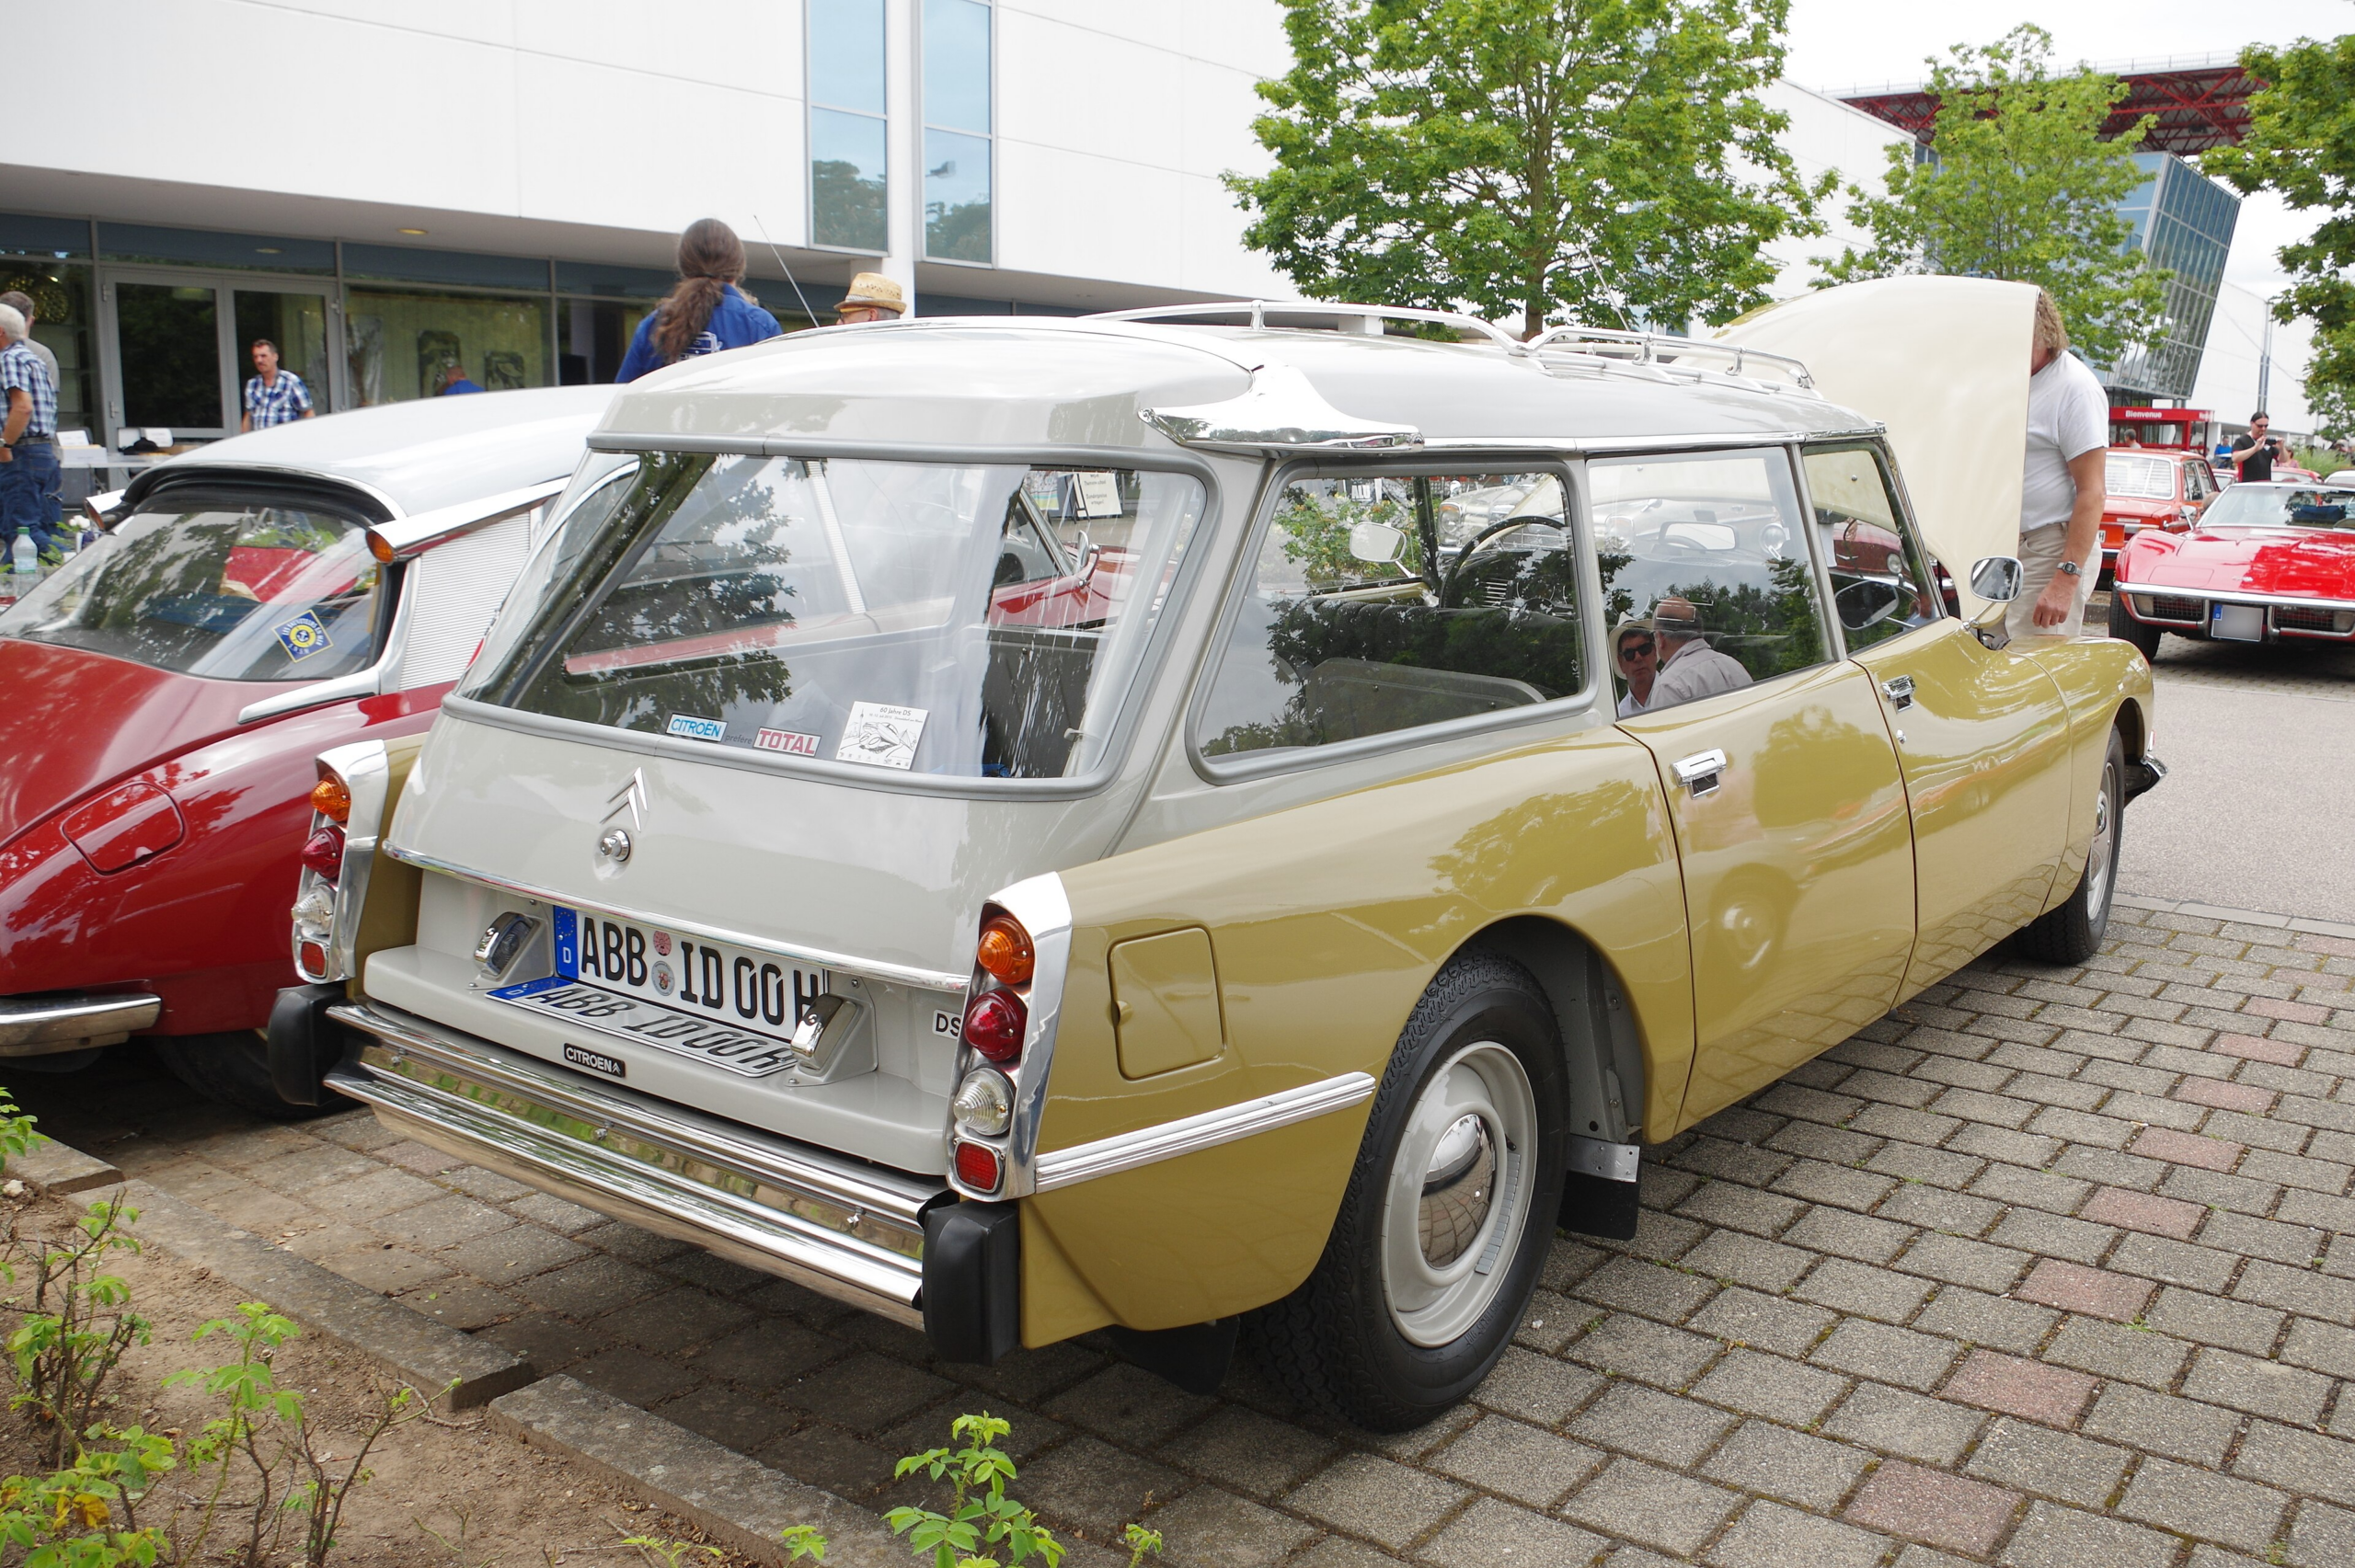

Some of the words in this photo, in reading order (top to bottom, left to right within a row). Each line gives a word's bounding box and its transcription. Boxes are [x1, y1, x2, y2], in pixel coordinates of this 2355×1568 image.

[2125, 410, 2163, 418] Bienvenue
[671, 718, 722, 737] CITROËN
[759, 730, 815, 754] TOTAL
[562, 946, 571, 964] D
[581, 917, 648, 987] ABB
[526, 987, 637, 1017] ABB
[936, 1013, 961, 1036] DS
[566, 1046, 612, 1071] CITROEN
